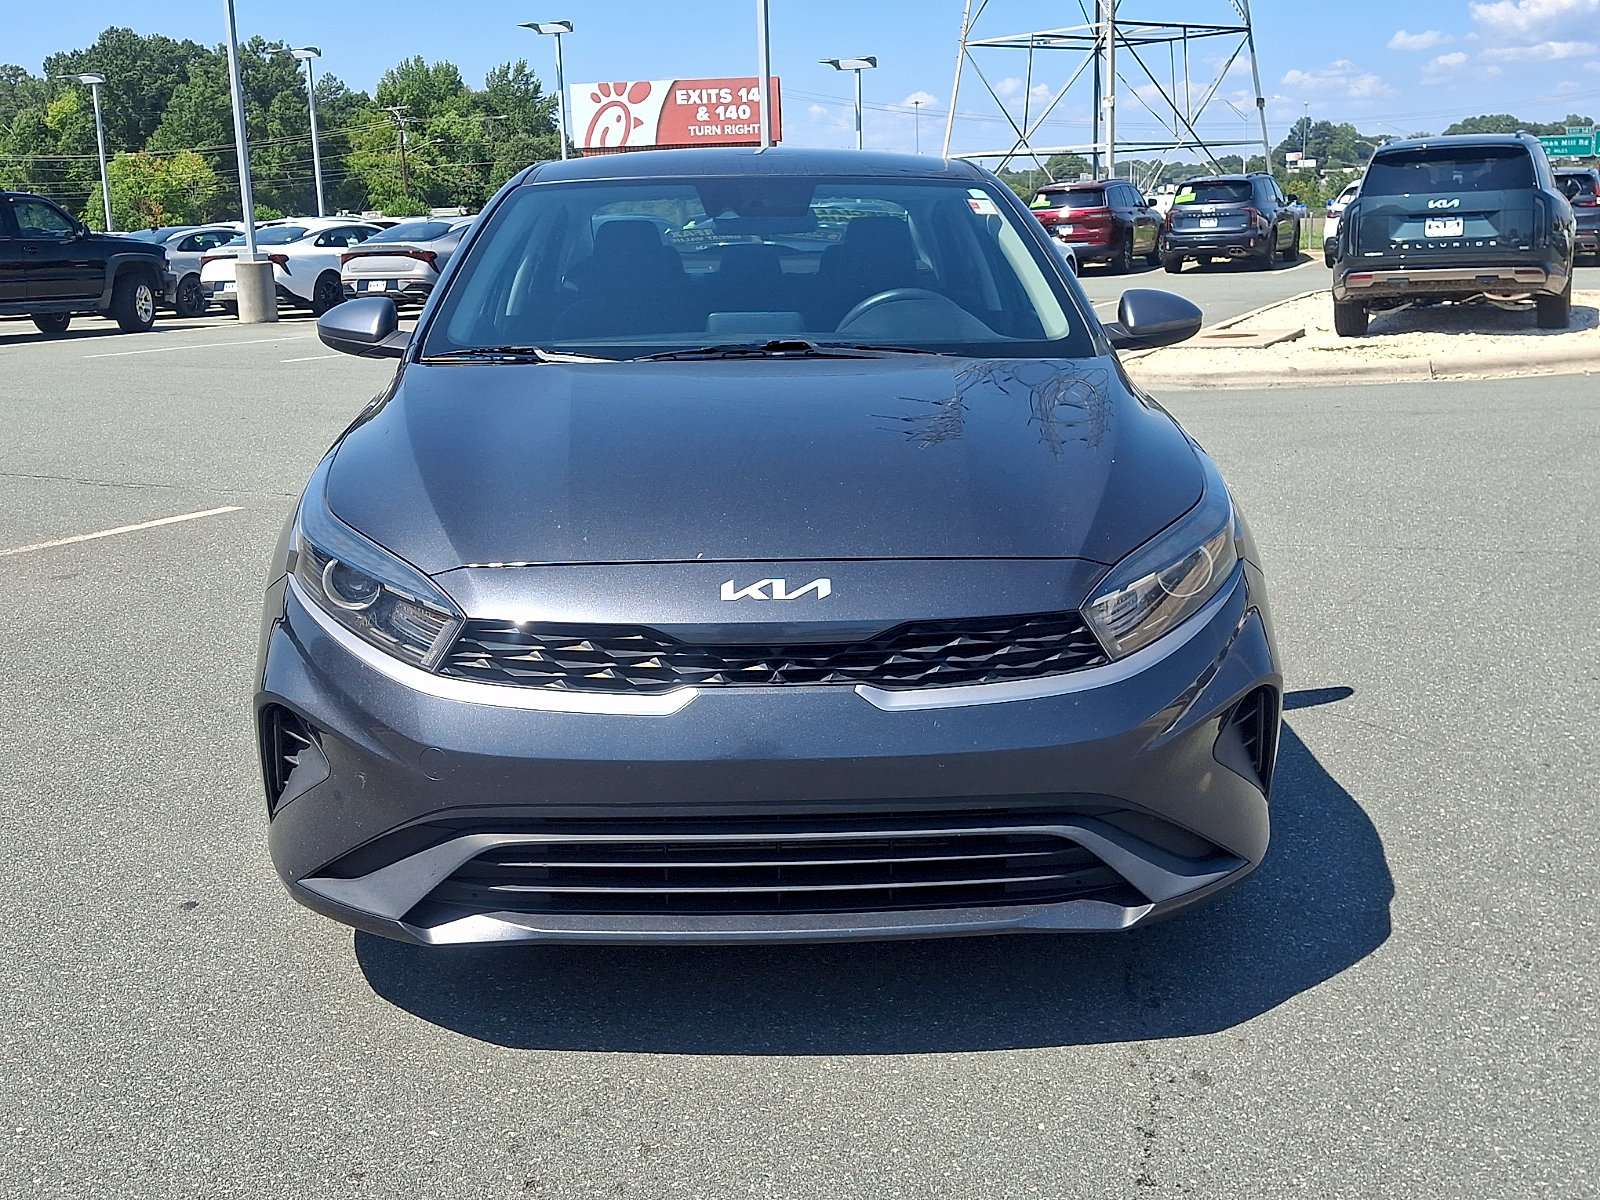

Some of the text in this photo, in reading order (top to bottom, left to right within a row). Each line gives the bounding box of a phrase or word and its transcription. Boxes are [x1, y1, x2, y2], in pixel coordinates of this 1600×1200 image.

[675, 87, 760, 105] EXITS 14
[696, 104, 751, 121] & 140
[688, 123, 760, 137] TURN RIGHT
[1578, 138, 1589, 146] Rd
[1428, 198, 1460, 209] KIA
[720, 578, 832, 601] KIA
